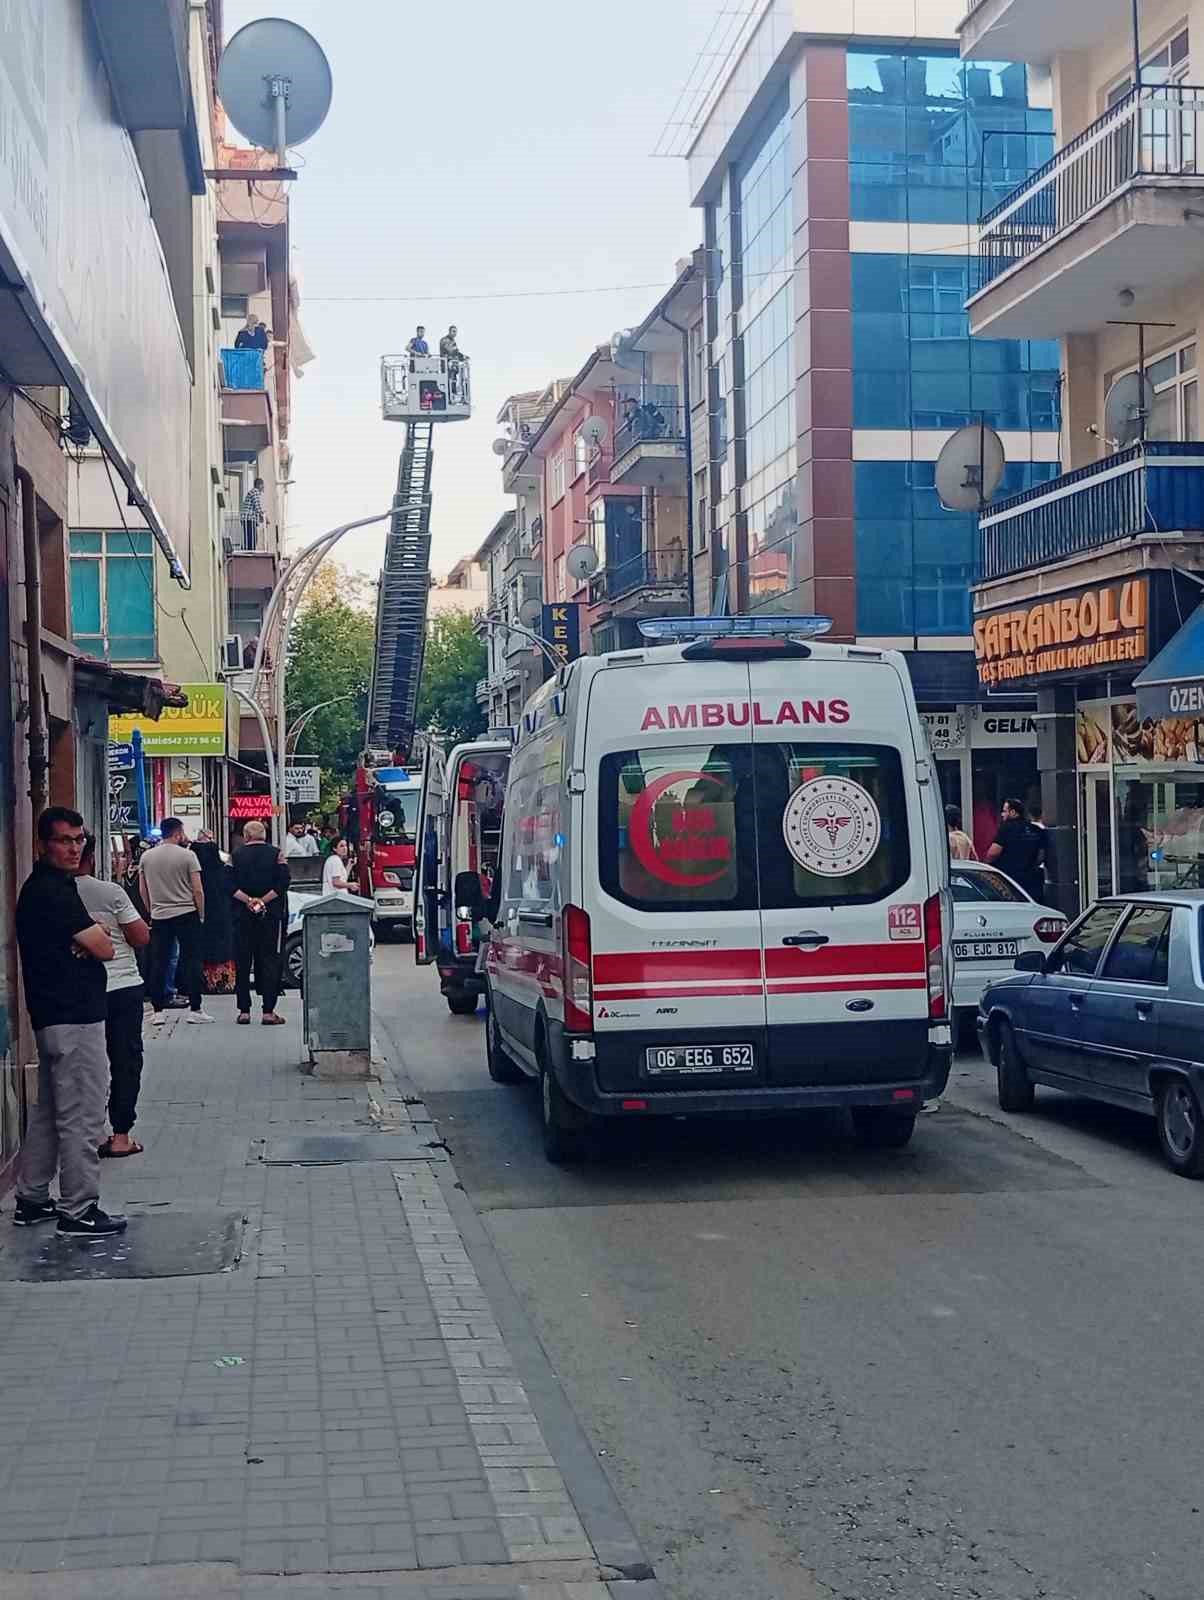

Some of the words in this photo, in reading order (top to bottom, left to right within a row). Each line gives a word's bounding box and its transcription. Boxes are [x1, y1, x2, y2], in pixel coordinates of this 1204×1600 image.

[974, 580, 1146, 661] SAFRANBOLU
[977, 663, 997, 687] TAŞ
[1026, 654, 1035, 674] &
[640, 699, 850, 731] AMBULANS
[284, 770, 312, 778] ALVAÇ
[891, 907, 916, 925] 112
[955, 944, 968, 956] 06
[973, 944, 992, 955] EJC
[998, 942, 1016, 954] 812
[657, 1050, 676, 1067] 06
[685, 1048, 713, 1066] EEG
[723, 1046, 752, 1064] 652
